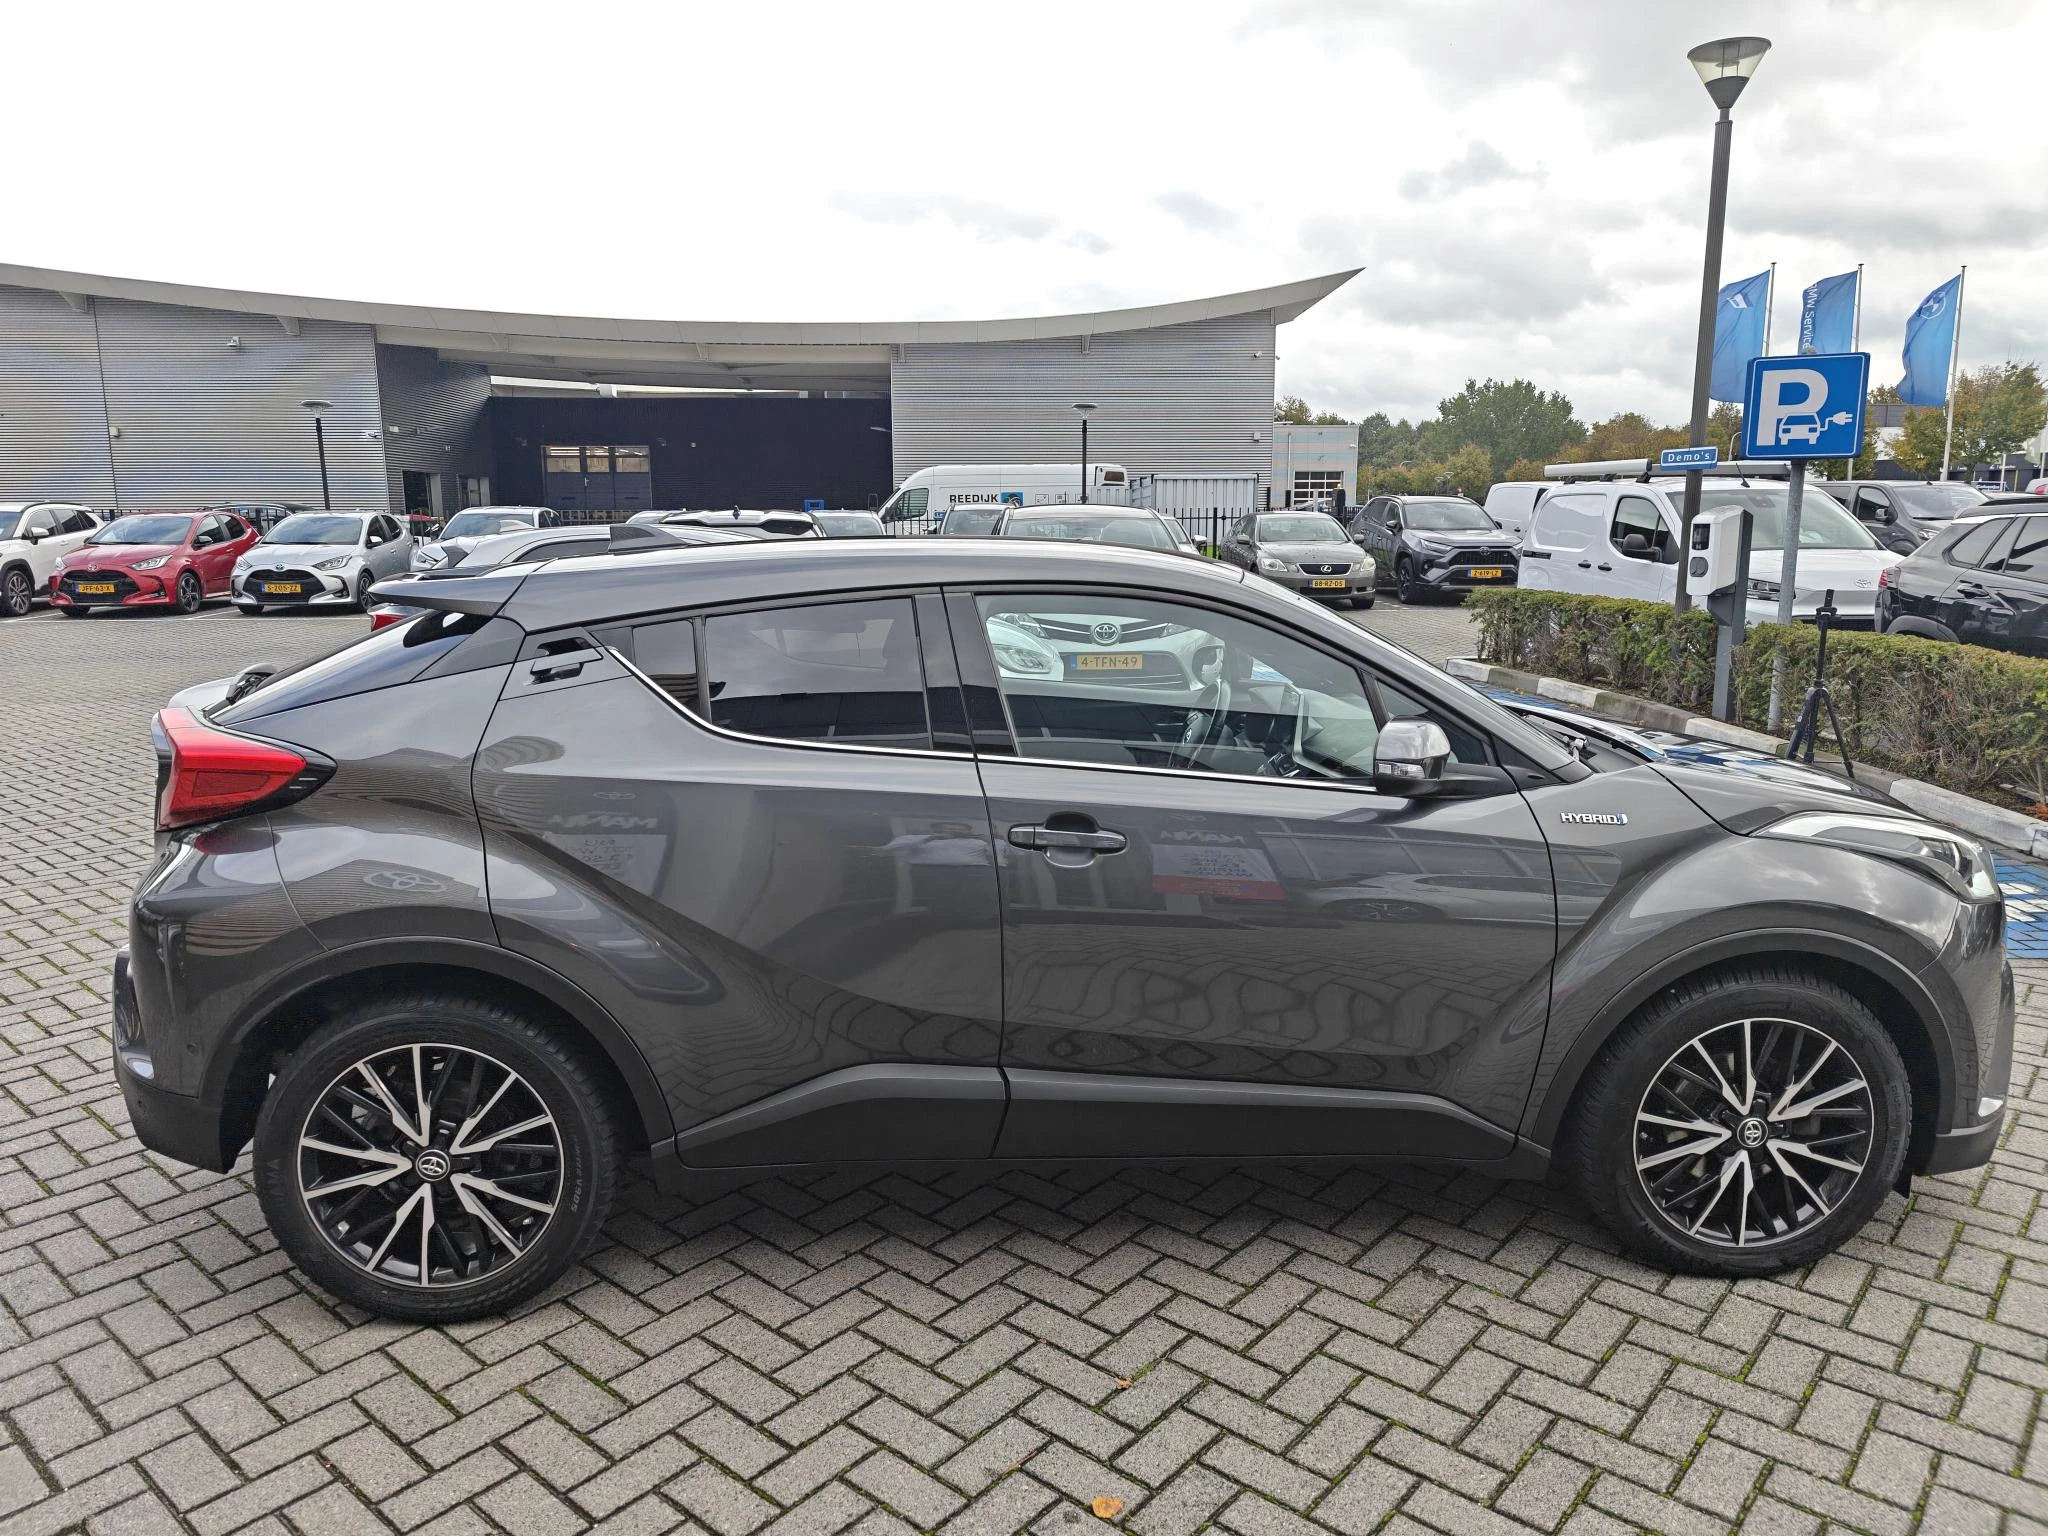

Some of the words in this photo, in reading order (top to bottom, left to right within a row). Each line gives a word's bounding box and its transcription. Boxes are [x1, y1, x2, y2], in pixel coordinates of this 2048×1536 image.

[1803, 311, 1815, 349] Service
[1757, 369, 1828, 446] P
[1668, 451, 1710, 462] Demo's
[950, 494, 999, 503] REEDIJK
[1081, 656, 1138, 668] 4-TFN-49
[1560, 812, 1618, 824] HYBRID
